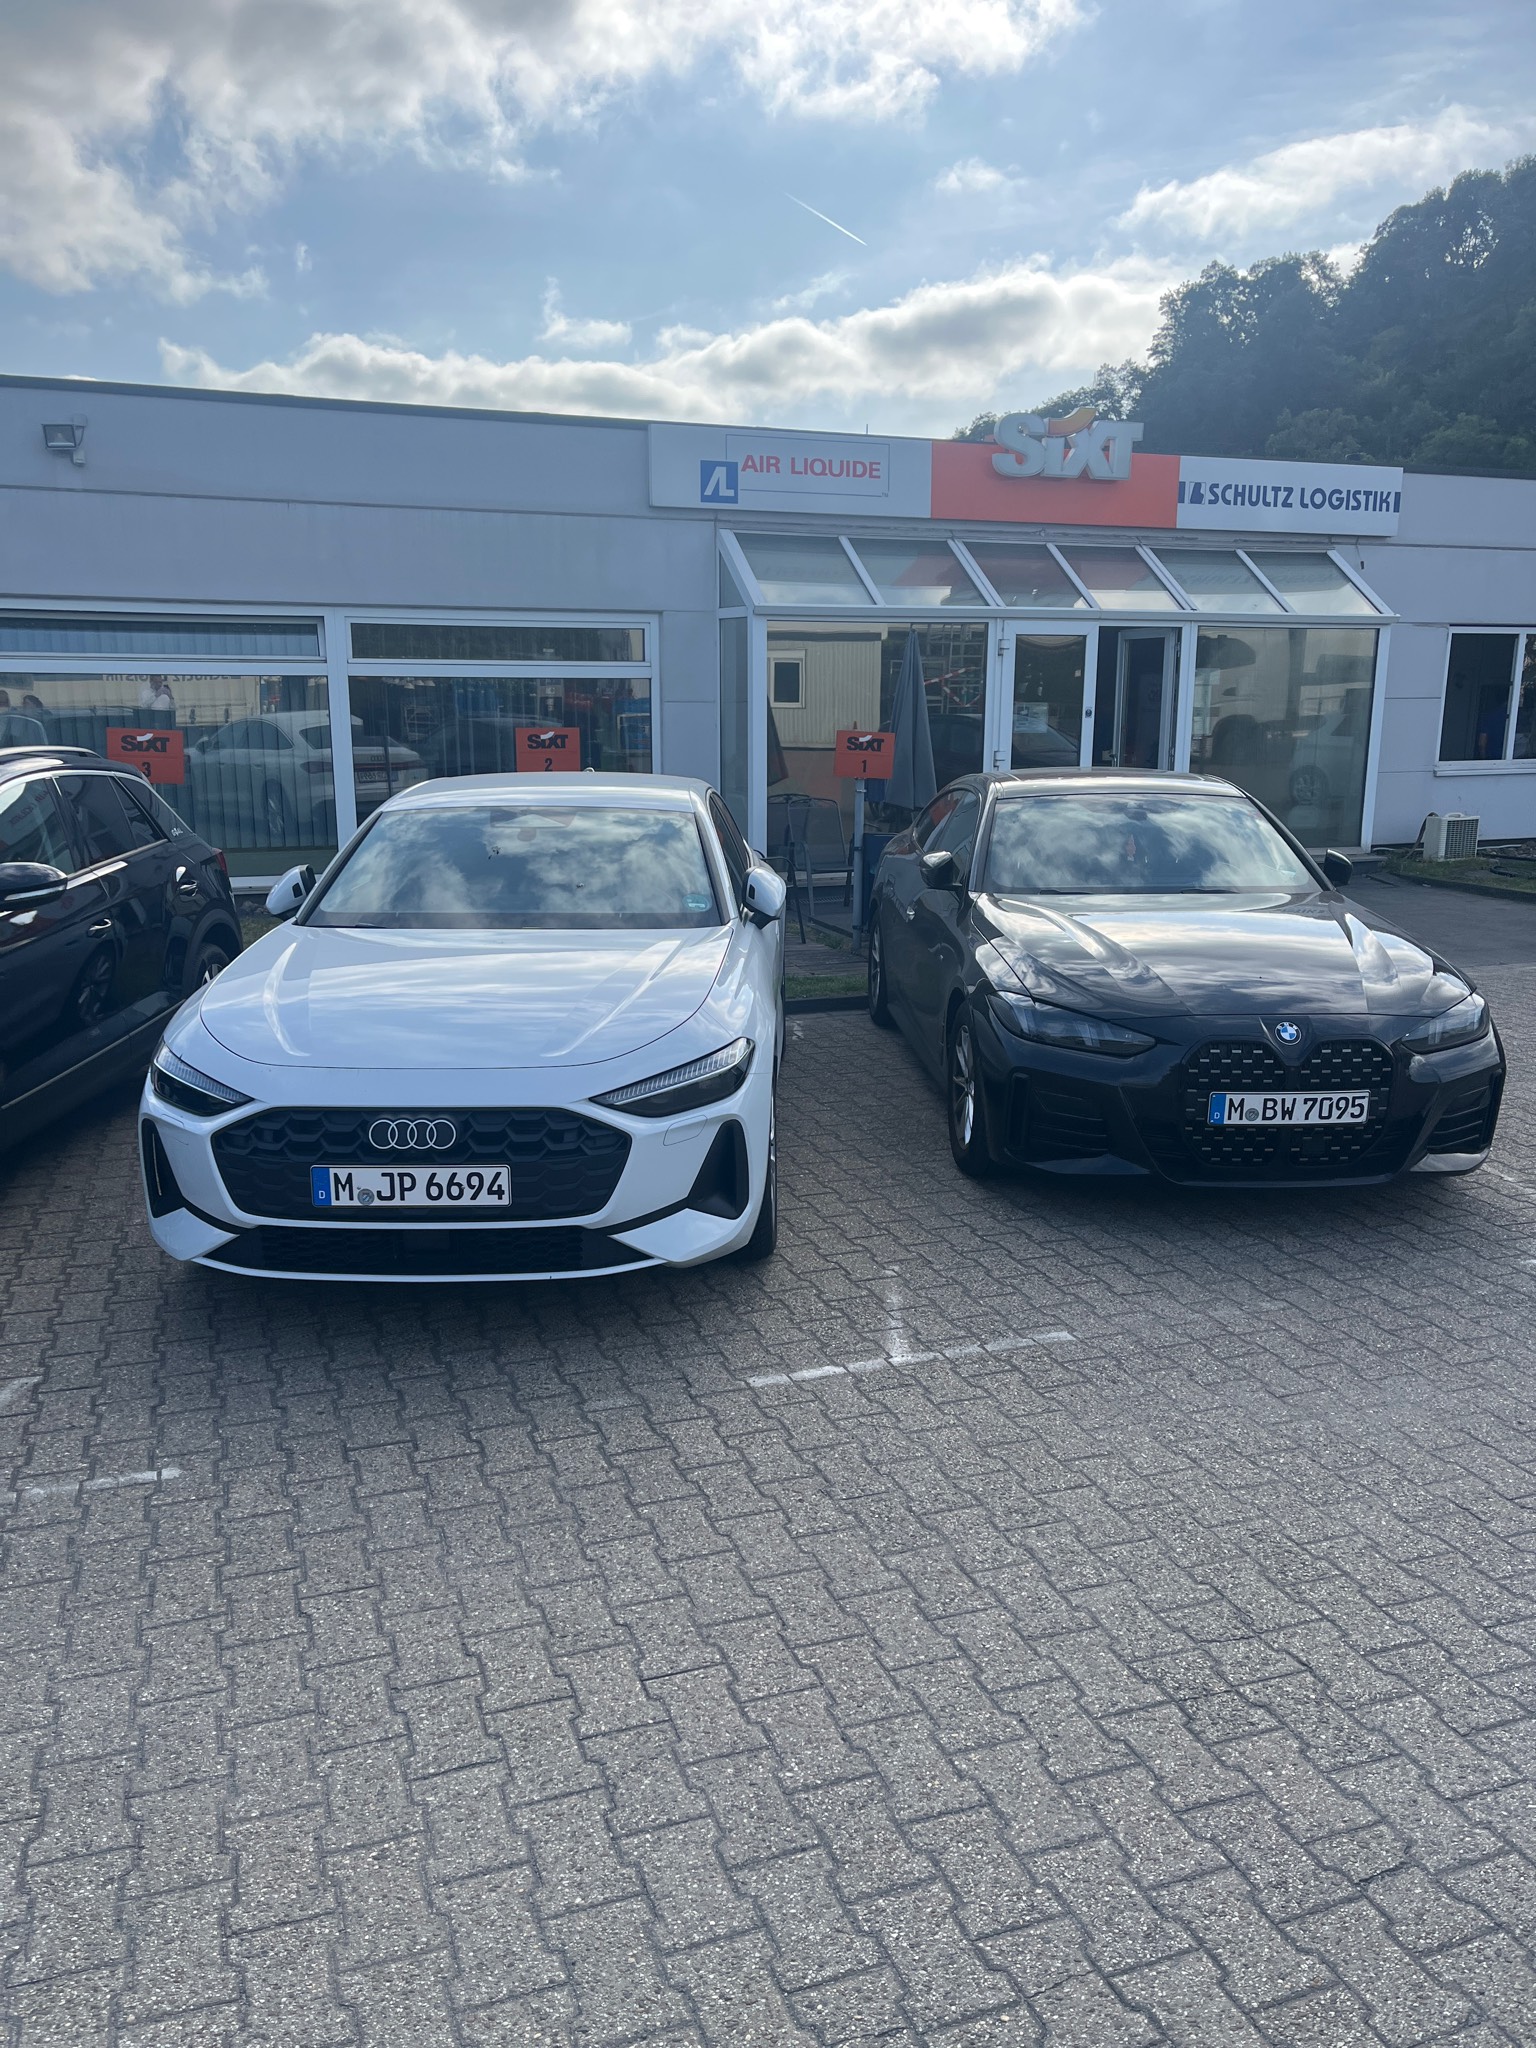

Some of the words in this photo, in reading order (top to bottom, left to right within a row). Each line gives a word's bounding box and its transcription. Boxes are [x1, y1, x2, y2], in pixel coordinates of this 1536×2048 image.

[741, 454, 781, 474] AIR
[790, 456, 881, 479] LIQUIDE
[1208, 482, 1294, 508] SCHULTZ
[1299, 487, 1391, 512] LOGISTIK
[121, 733, 170, 753] SIXT
[527, 731, 569, 750] SIXT
[847, 735, 885, 752] SIXT
[141, 761, 152, 778] 3
[544, 758, 553, 772] 2
[862, 759, 867, 773] 1
[1214, 1111, 1221, 1120] D
[1227, 1098, 1246, 1121] M
[1261, 1097, 1297, 1121] BW
[1303, 1096, 1367, 1120] 7095
[318, 1190, 326, 1199] D
[333, 1172, 354, 1201] M
[376, 1172, 417, 1201] JP
[425, 1172, 506, 1201] 6694
